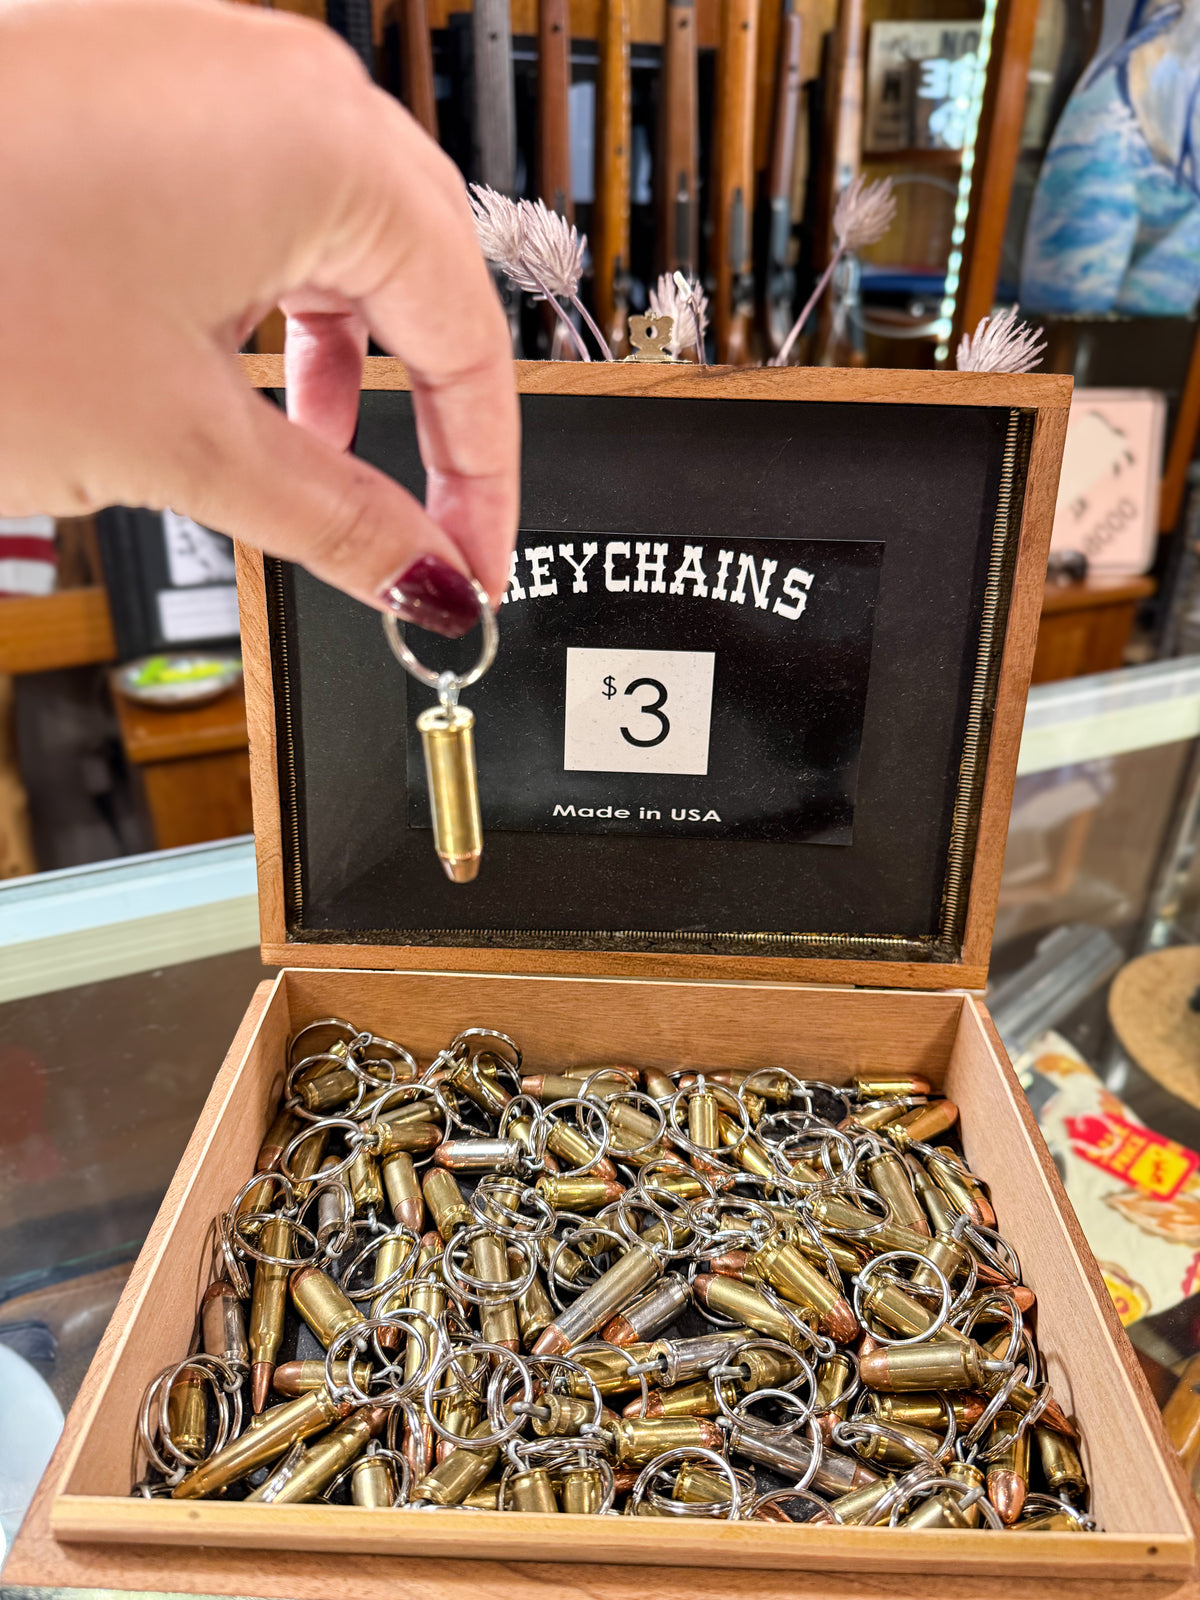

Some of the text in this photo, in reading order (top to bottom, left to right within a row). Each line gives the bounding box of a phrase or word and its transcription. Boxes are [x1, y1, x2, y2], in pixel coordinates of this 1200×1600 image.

[601, 675, 671, 748] $3
[552, 804, 722, 823] Made in USA
